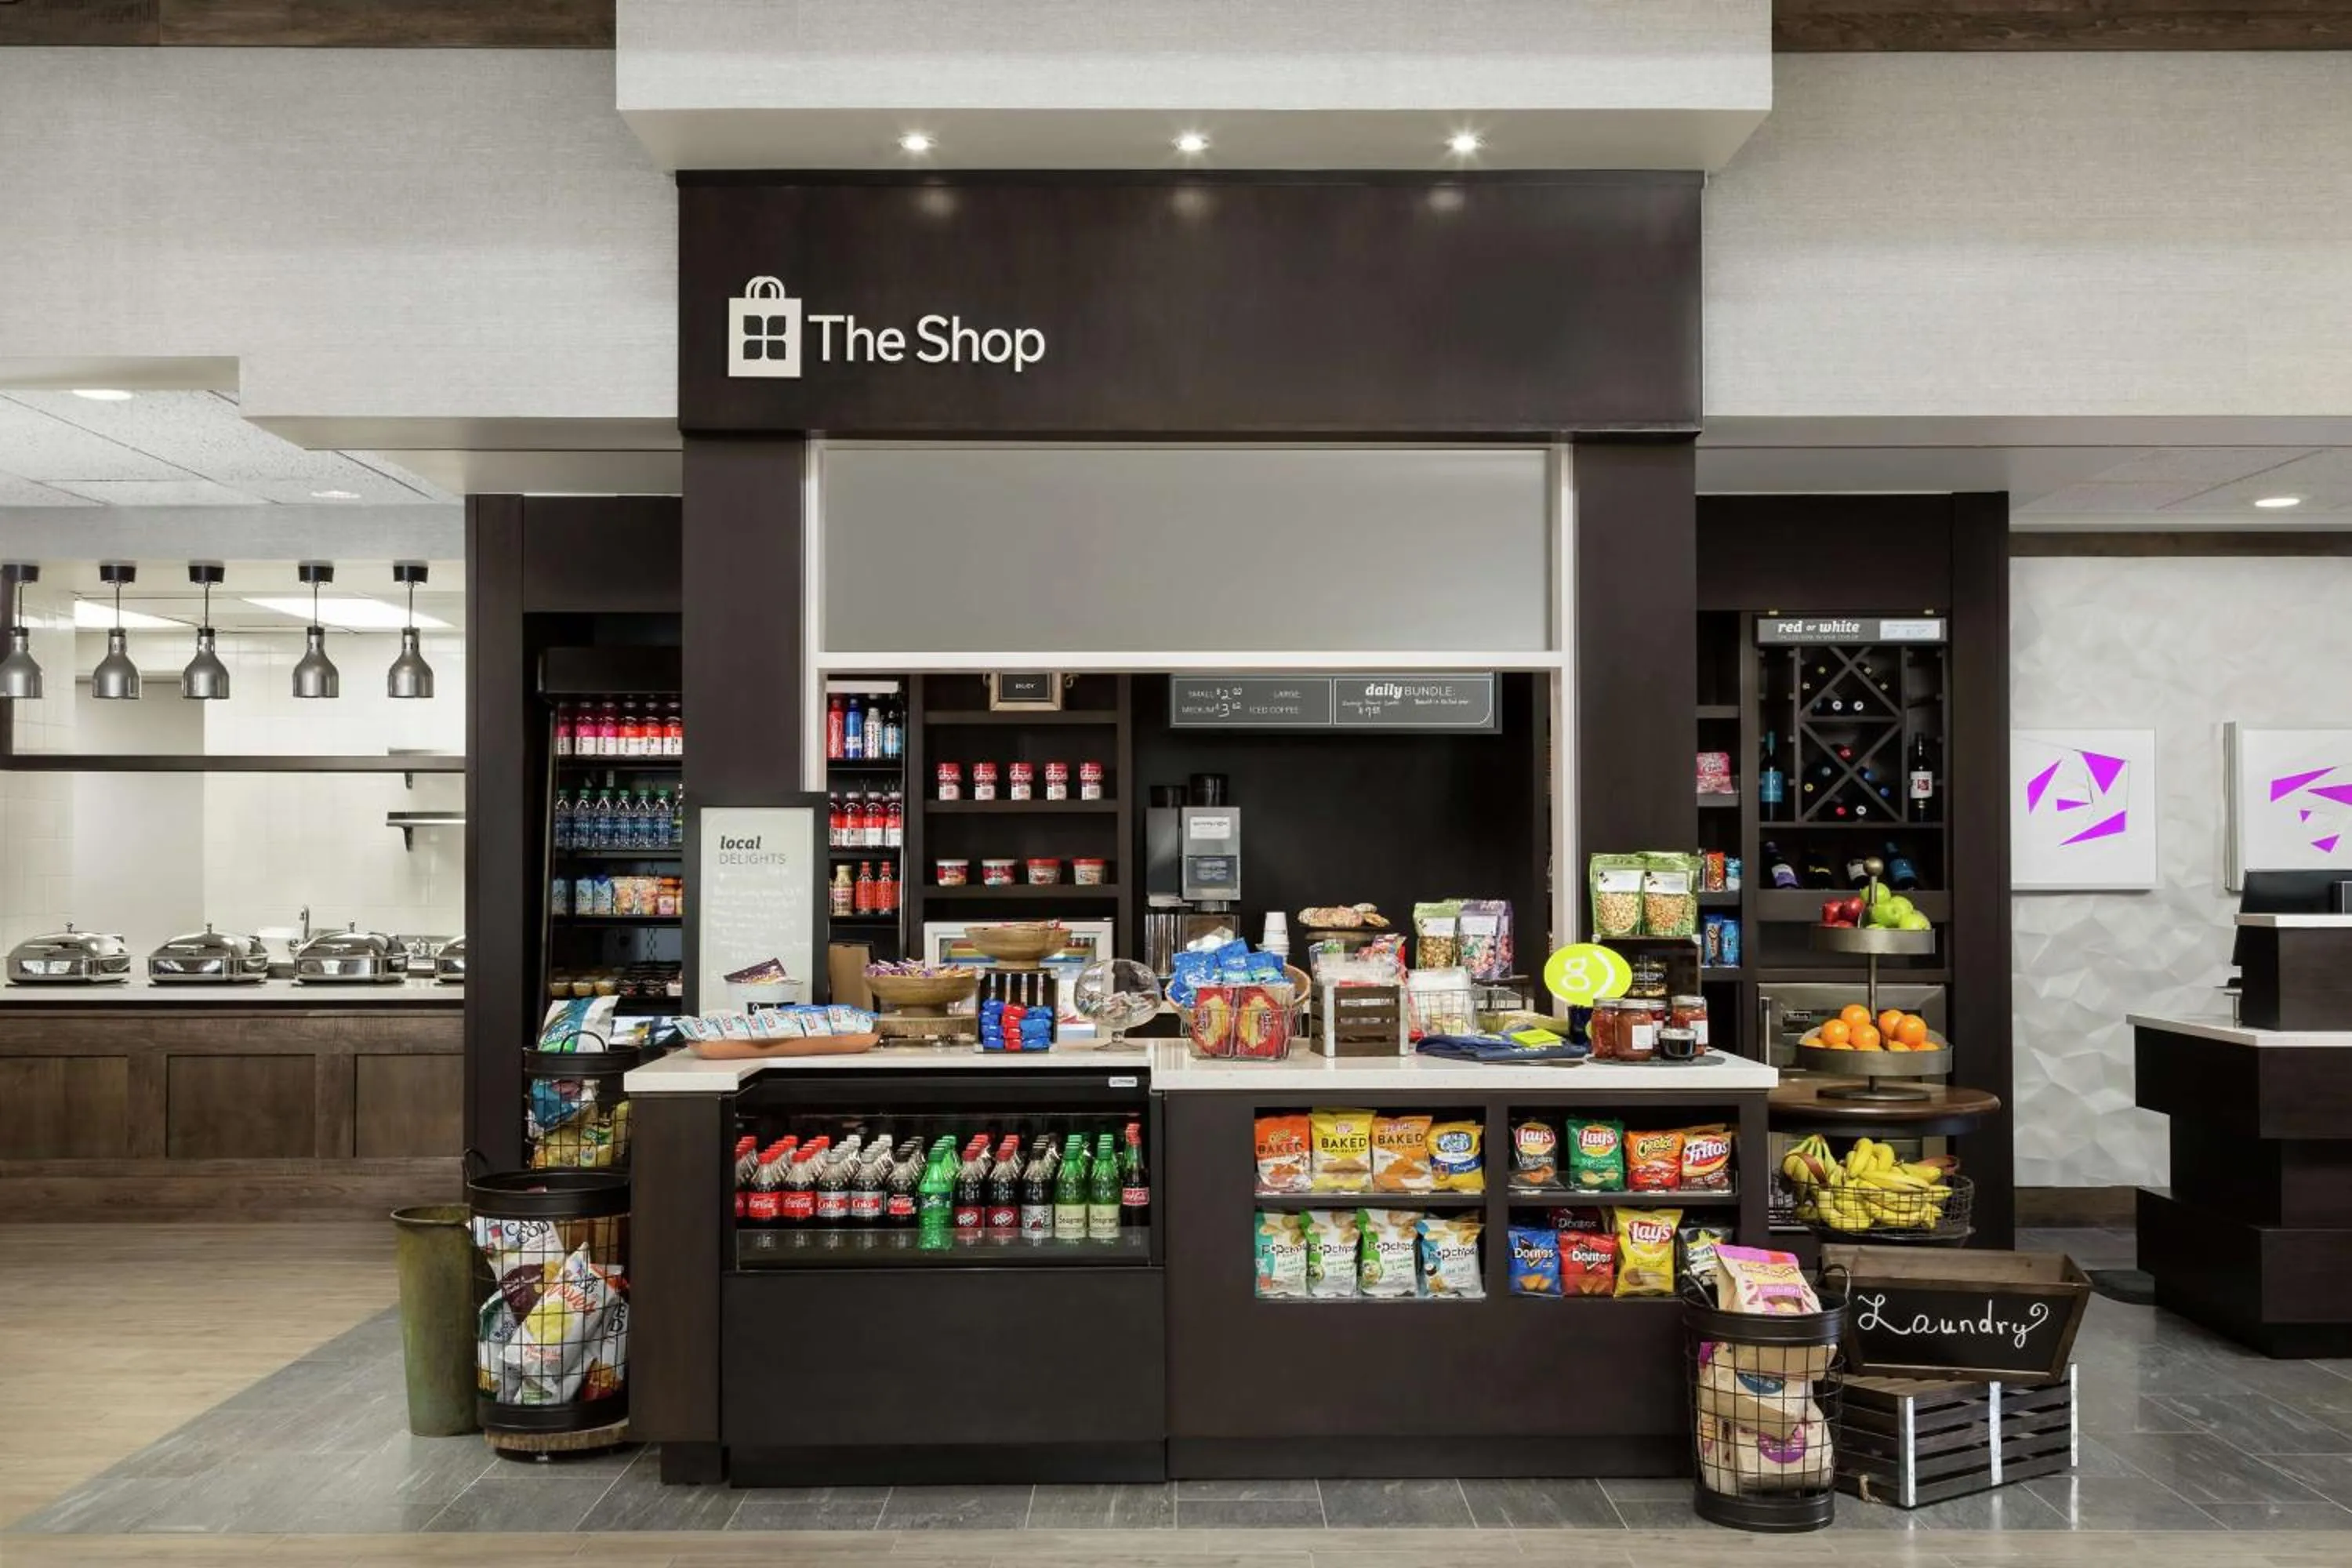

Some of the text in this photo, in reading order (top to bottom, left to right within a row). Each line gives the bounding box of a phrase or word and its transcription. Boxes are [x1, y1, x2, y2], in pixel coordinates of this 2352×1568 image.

[808, 314, 1046, 372] The Shop
[1777, 620, 1802, 633] red
[1819, 620, 1860, 633] white
[1365, 683, 1403, 699] daily
[720, 835, 762, 850] local
[719, 853, 786, 865] DELIGHTS
[1321, 1137, 1367, 1149] BAKED
[1377, 1133, 1423, 1145] BAKED
[1686, 1140, 1728, 1164] Fritos
[1632, 1222, 1671, 1243] Lay's
[1514, 1247, 1555, 1258] Doritos
[1572, 1250, 1612, 1262] Doritos
[1857, 1294, 2049, 1348] Laundry
